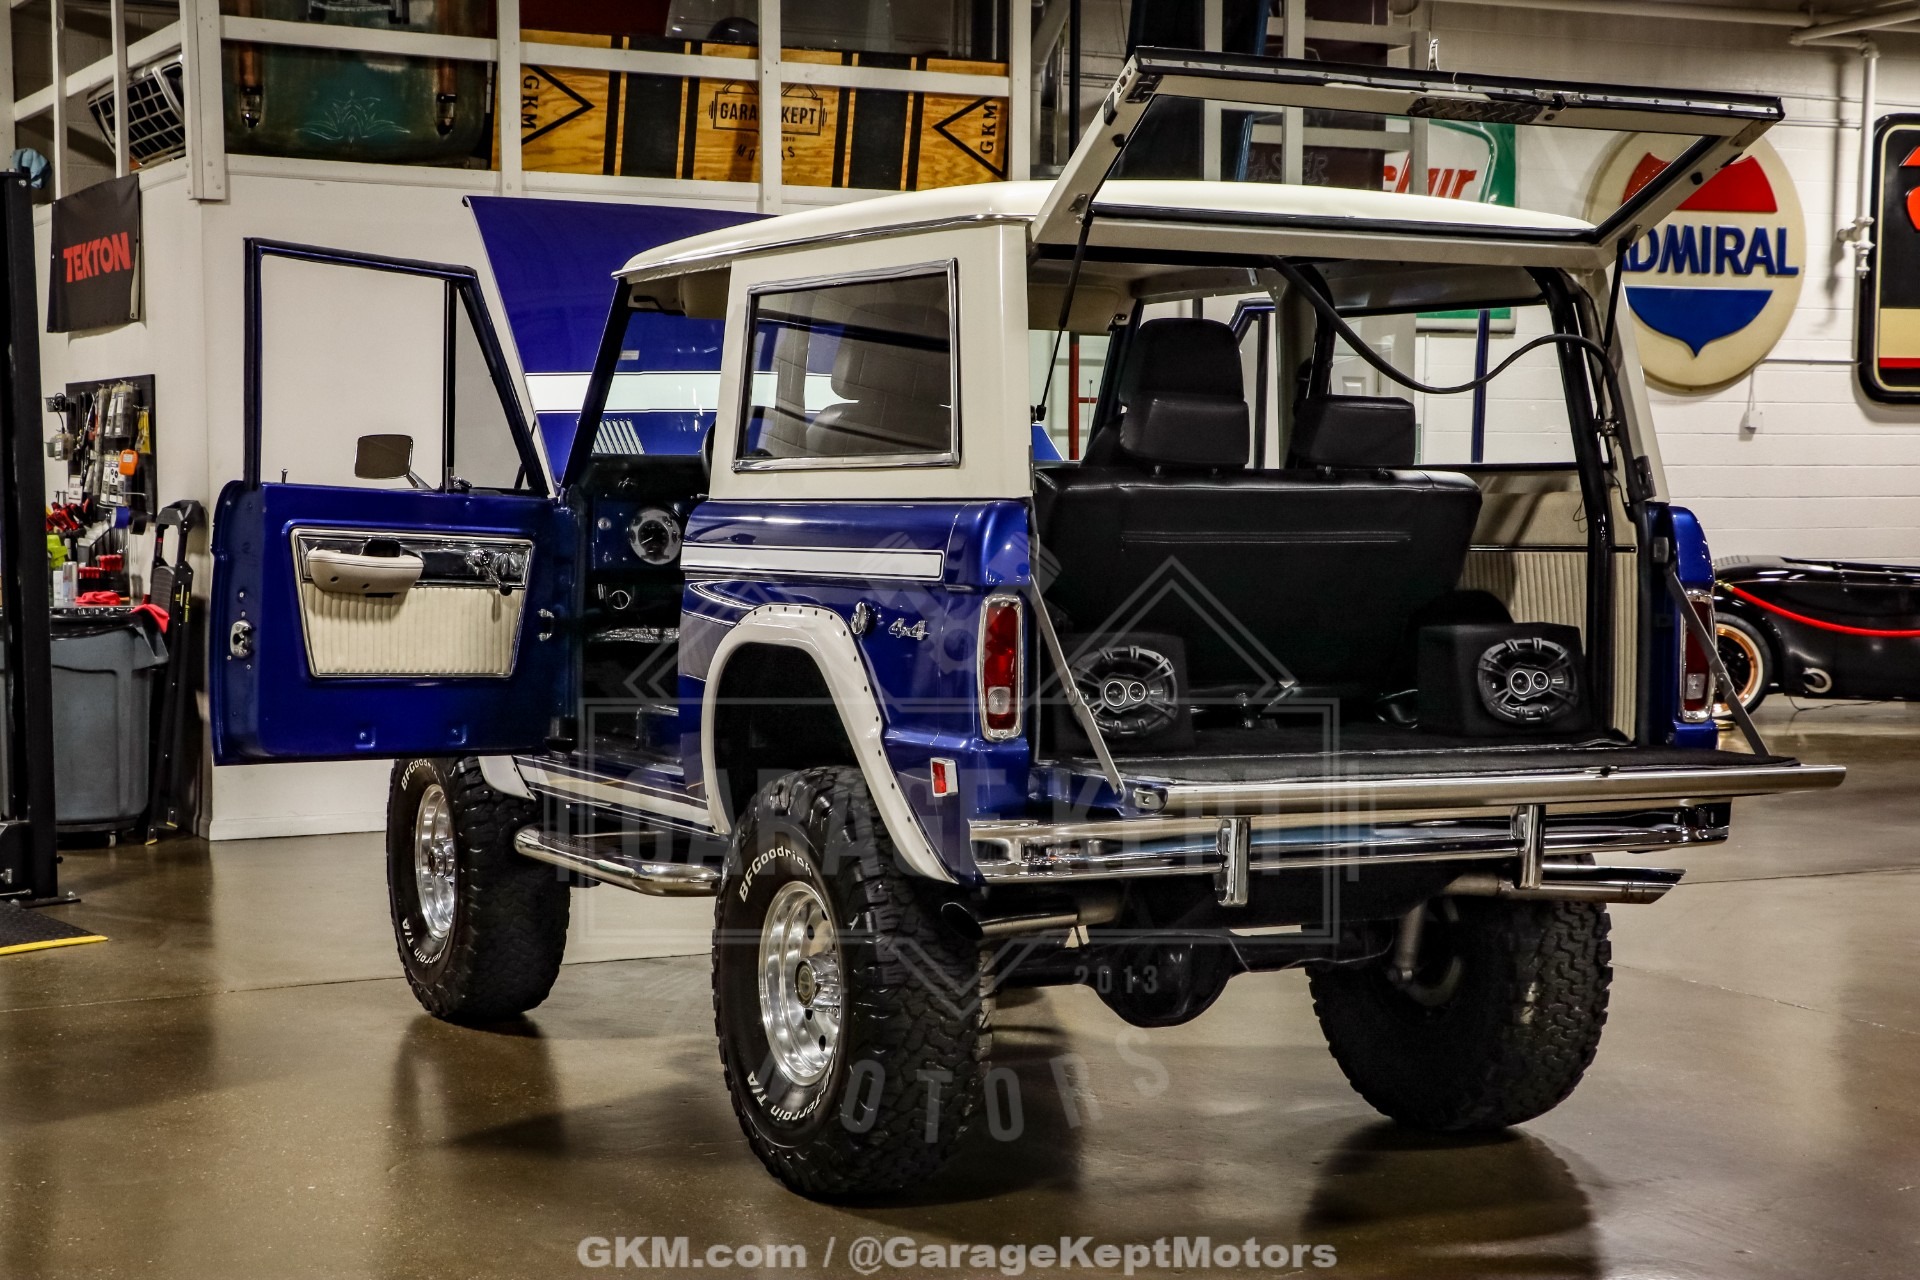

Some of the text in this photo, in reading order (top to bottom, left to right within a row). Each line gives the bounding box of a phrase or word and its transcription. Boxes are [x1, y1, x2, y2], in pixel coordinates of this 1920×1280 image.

[521, 75, 540, 130] GKM
[720, 103, 816, 125] GARA KEPT
[980, 104, 998, 154] GKM
[63, 232, 131, 283] TEKTON
[1622, 223, 1799, 276] DMIRAL
[739, 845, 813, 903] BFGoodrich
[747, 1070, 768, 1107] T/A
